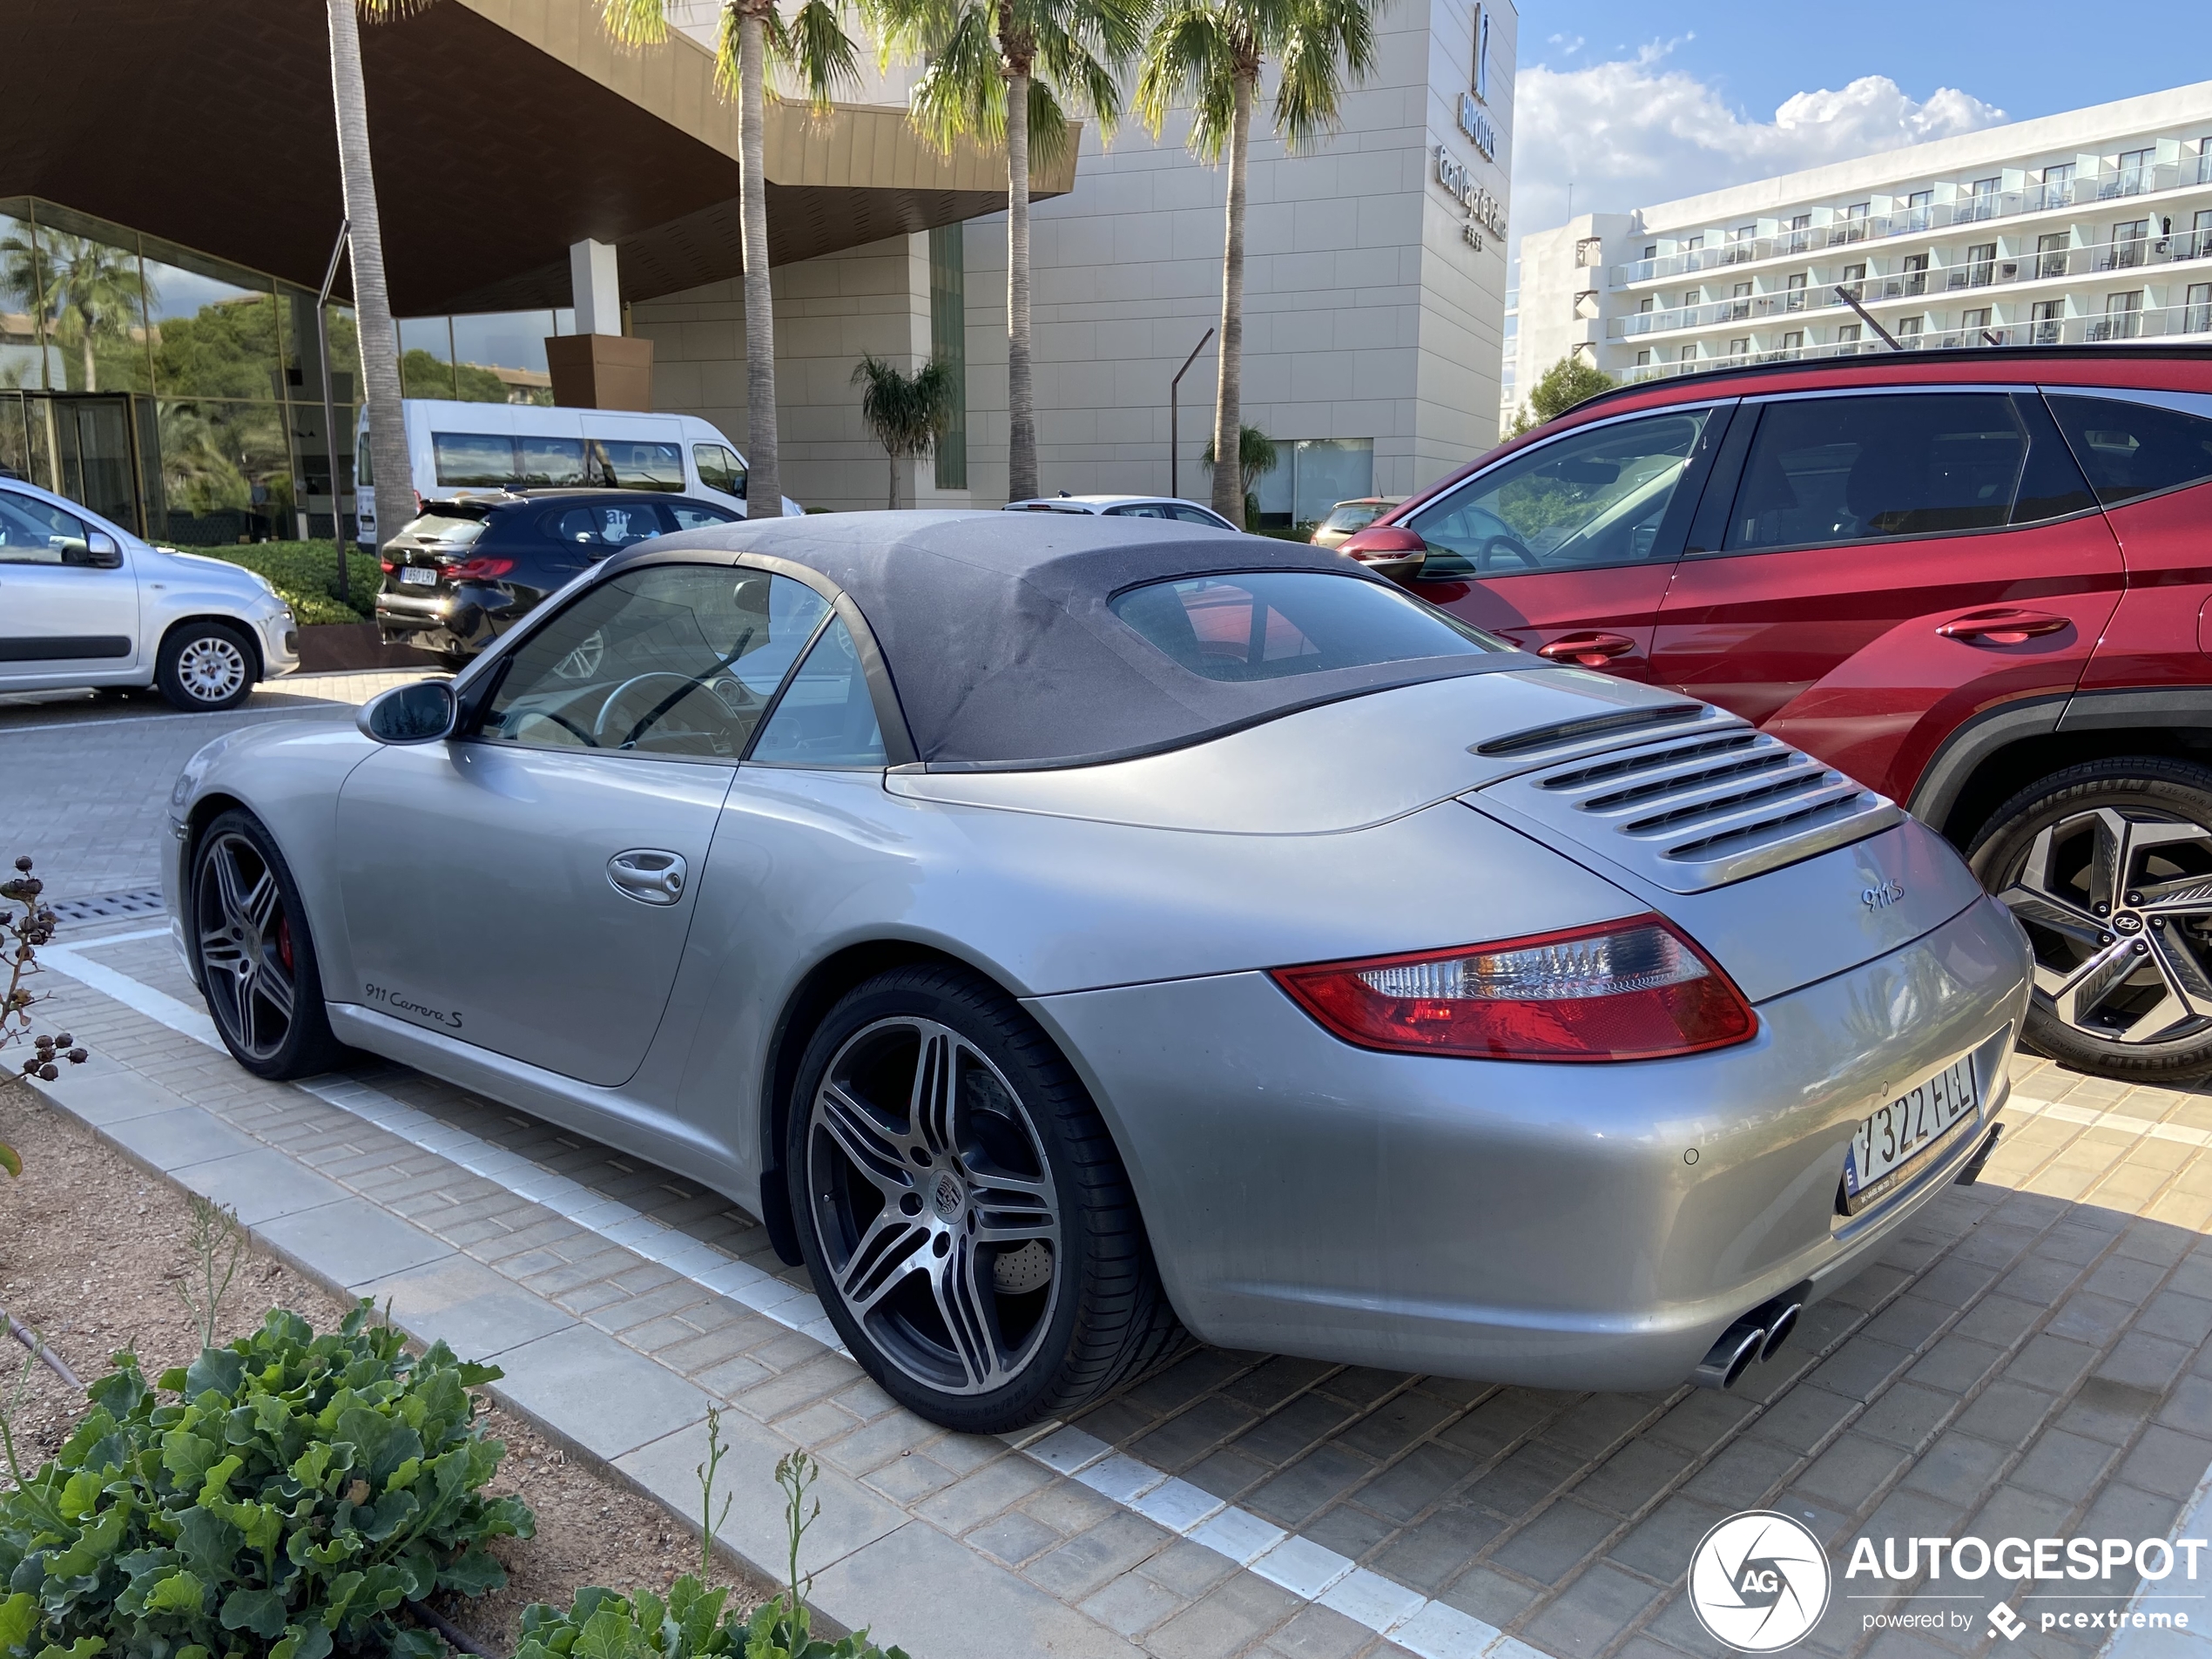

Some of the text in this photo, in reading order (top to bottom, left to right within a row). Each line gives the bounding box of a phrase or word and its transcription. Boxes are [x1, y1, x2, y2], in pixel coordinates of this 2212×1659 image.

[1436, 145, 1459, 197] Gran
[421, 570, 435, 583] LRV
[2029, 779, 2144, 814] MICHELIN
[366, 983, 462, 1028] 911 Carrera S
[1858, 1087, 1928, 1177] 7322
[1845, 1168, 1853, 1186] E
